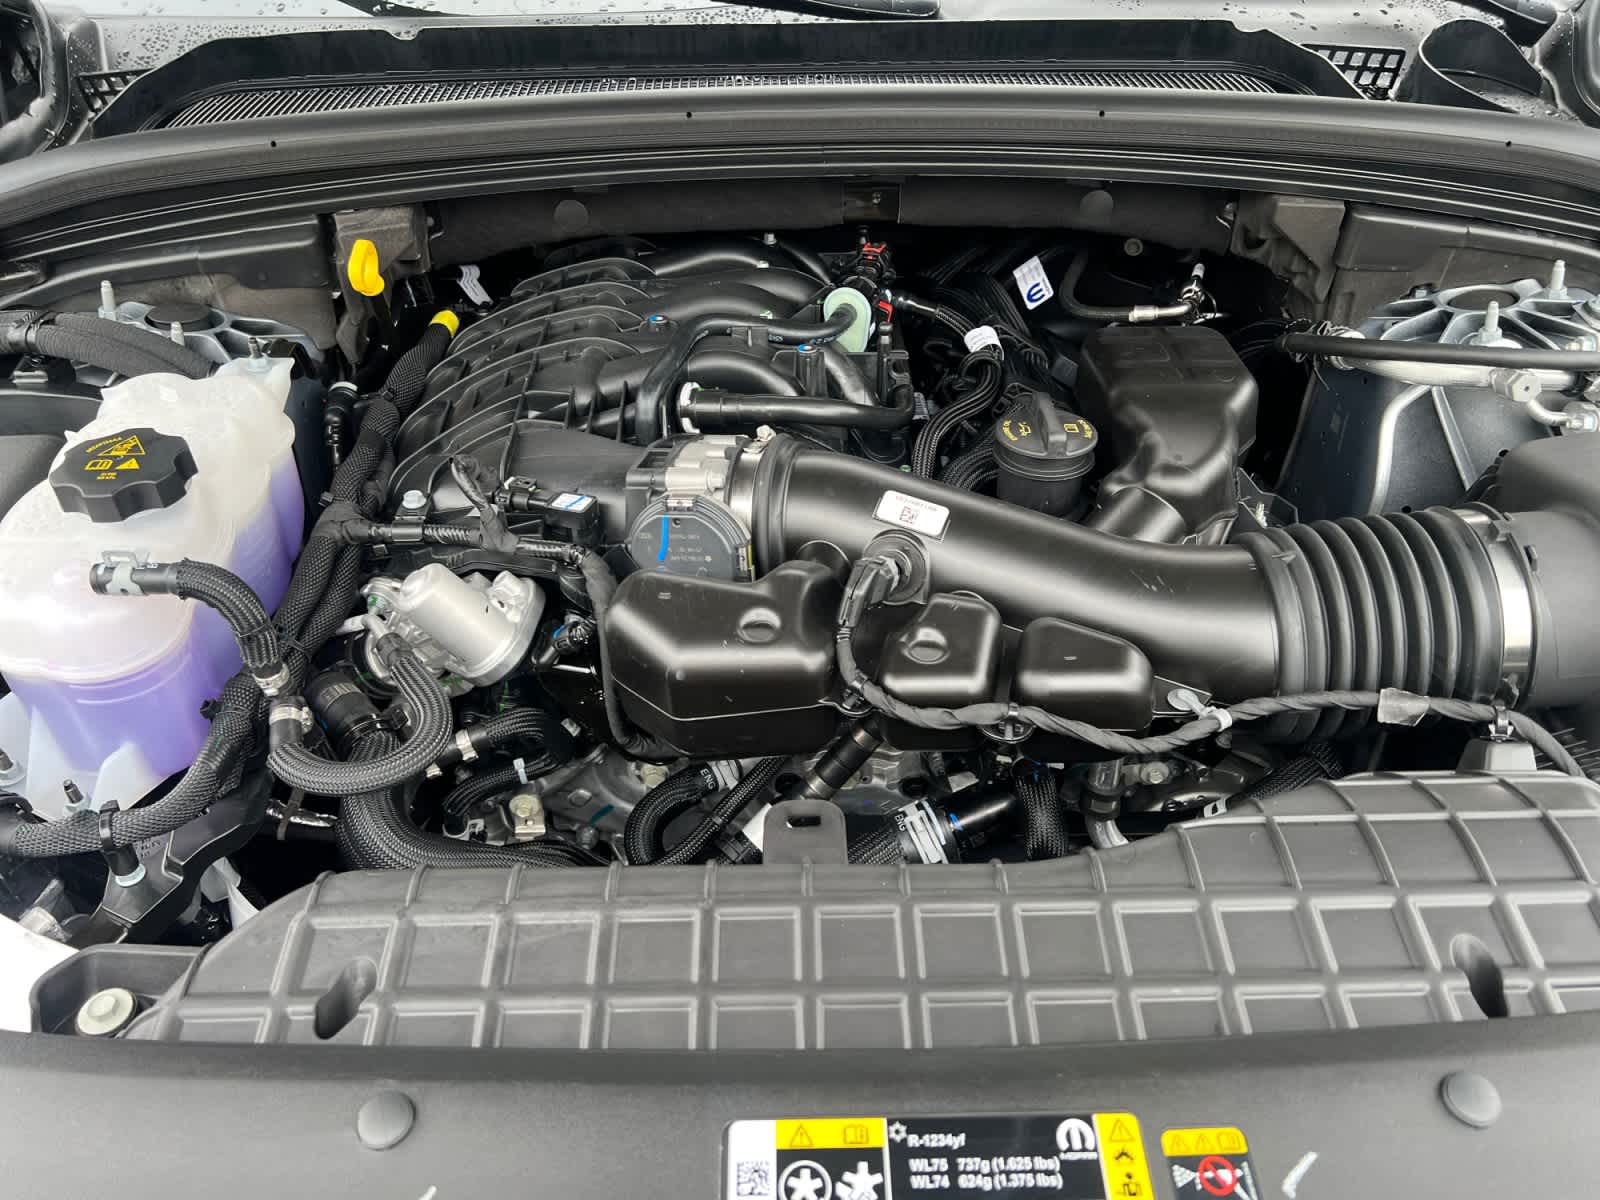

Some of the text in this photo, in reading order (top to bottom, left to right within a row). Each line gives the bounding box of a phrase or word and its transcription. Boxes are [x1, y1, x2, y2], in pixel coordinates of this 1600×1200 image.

[700, 768, 716, 790] ENG
[907, 1133, 966, 1150] R-1234yf
[908, 1158, 949, 1173] WL75
[956, 1157, 991, 1174] 737g
[1033, 1155, 1061, 1172] lbs)
[910, 1174, 951, 1190] WL74
[993, 1173, 1035, 1191] (1.375
[1035, 1172, 1063, 1190] lbs)
